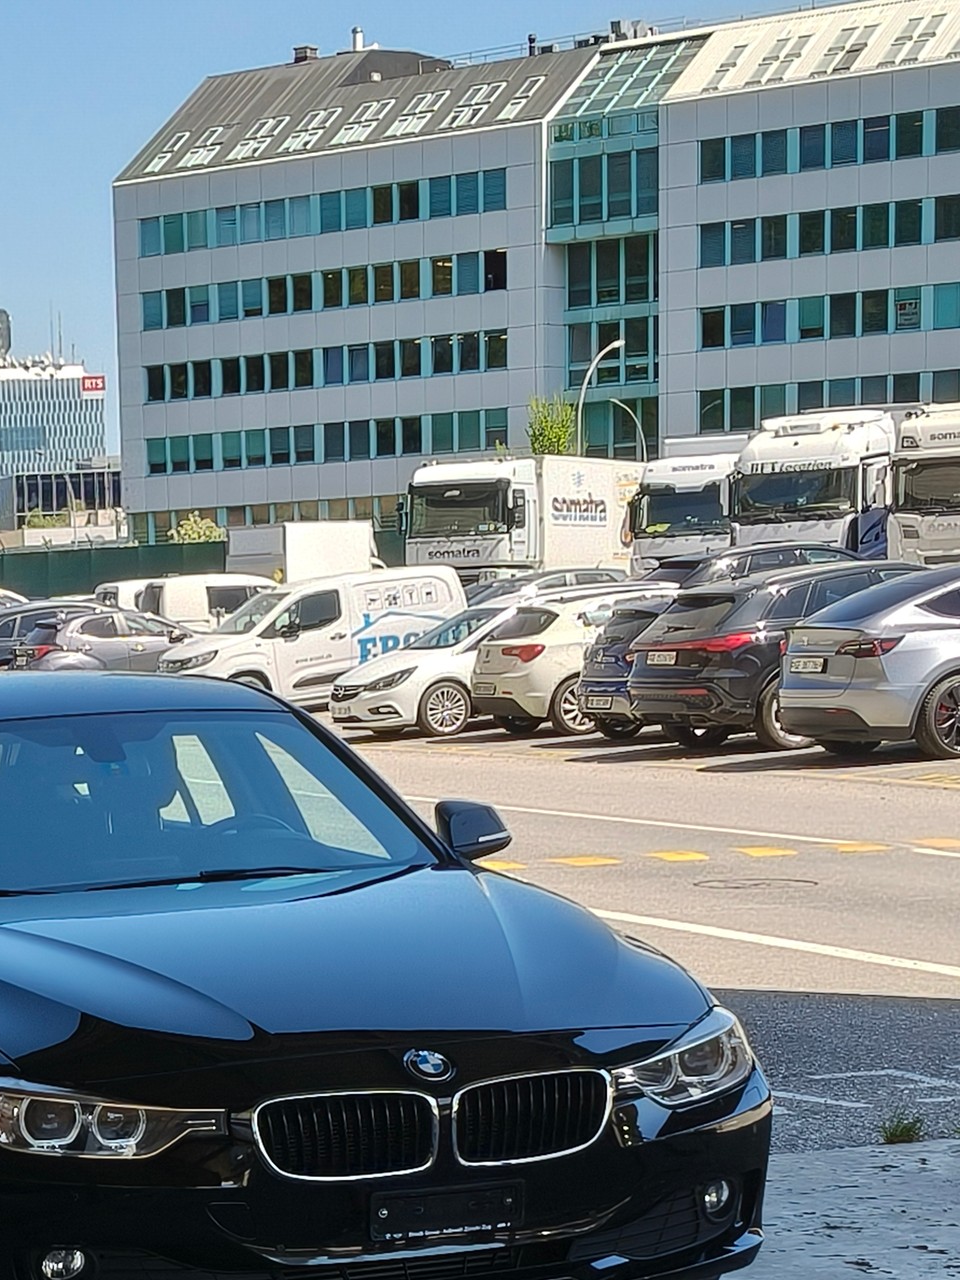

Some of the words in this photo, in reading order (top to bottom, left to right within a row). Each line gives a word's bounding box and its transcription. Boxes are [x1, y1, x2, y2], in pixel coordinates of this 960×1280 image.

[84, 378, 104, 389] RTS
[671, 463, 716, 473] somatra
[428, 547, 480, 560] somatra
